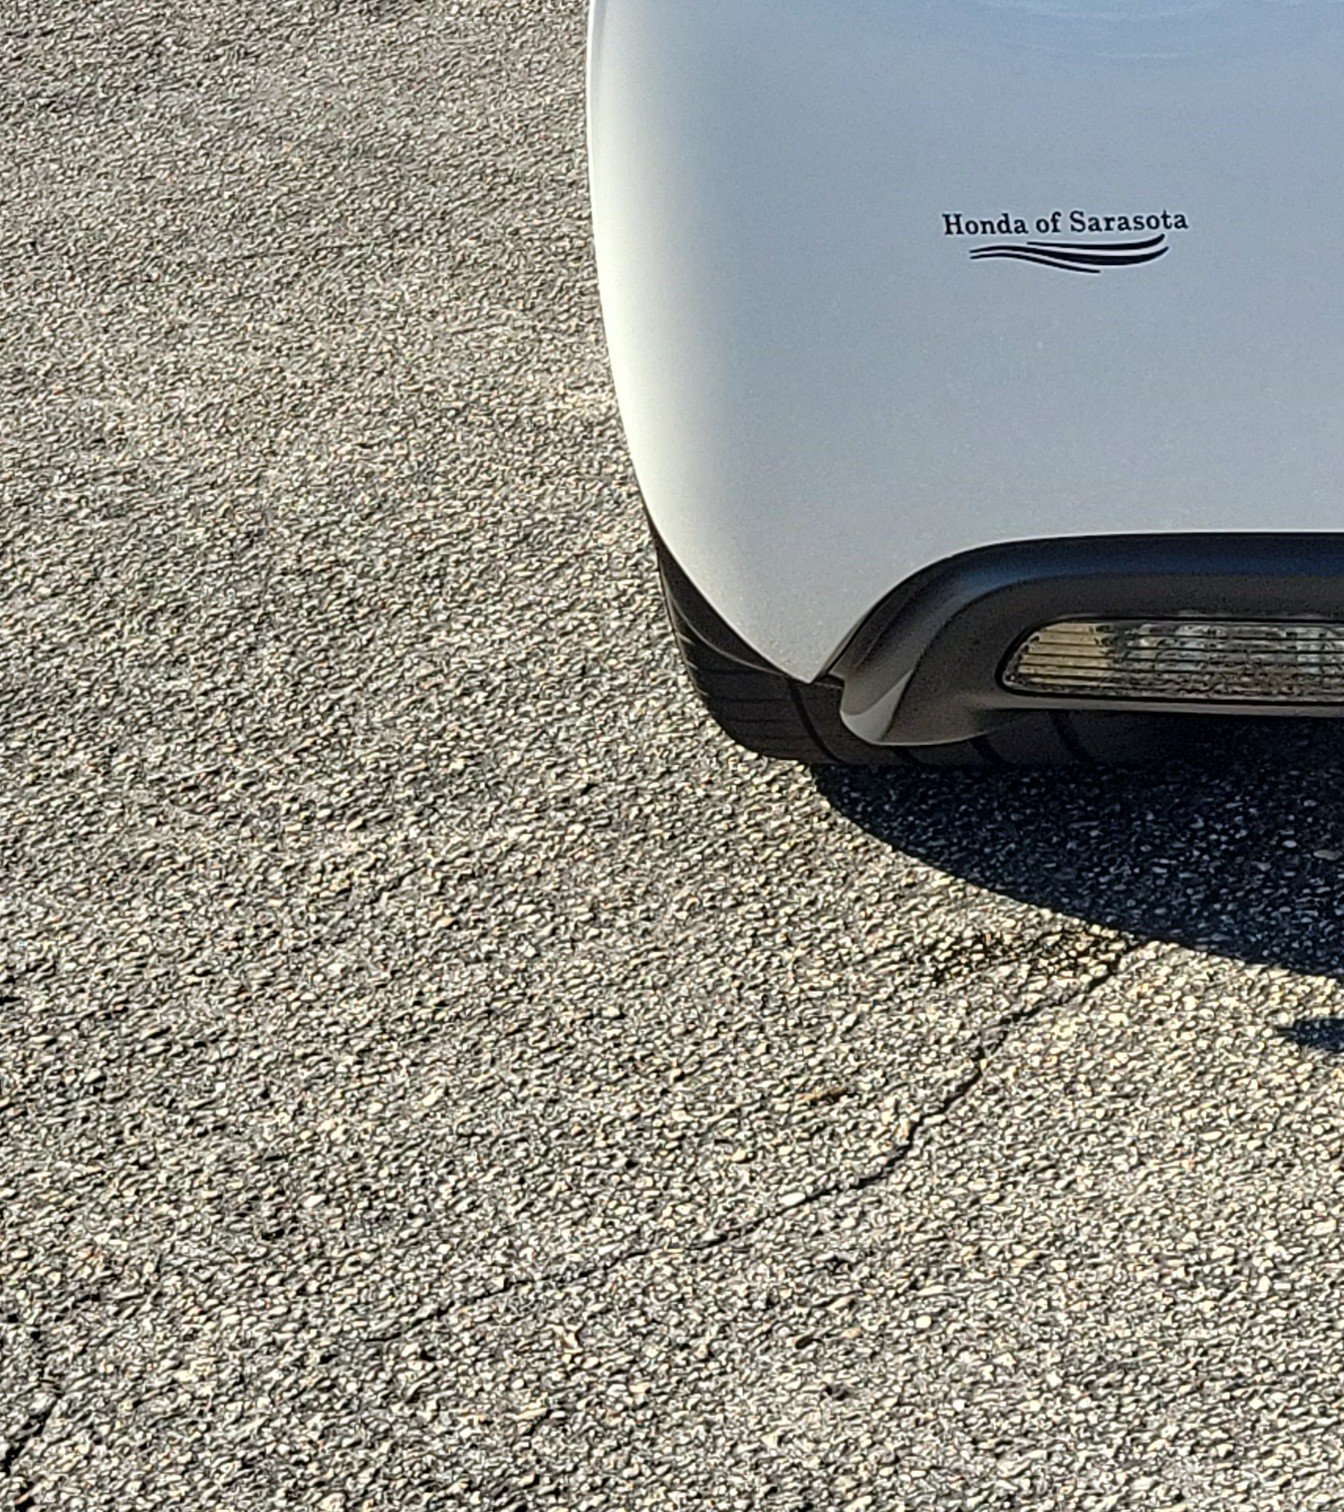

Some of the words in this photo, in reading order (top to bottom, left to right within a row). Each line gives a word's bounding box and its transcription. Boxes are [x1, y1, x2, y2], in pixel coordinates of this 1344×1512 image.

[941, 212, 1029, 236] Honda
[1035, 210, 1062, 233] of
[1069, 209, 1189, 233] Sarasota
